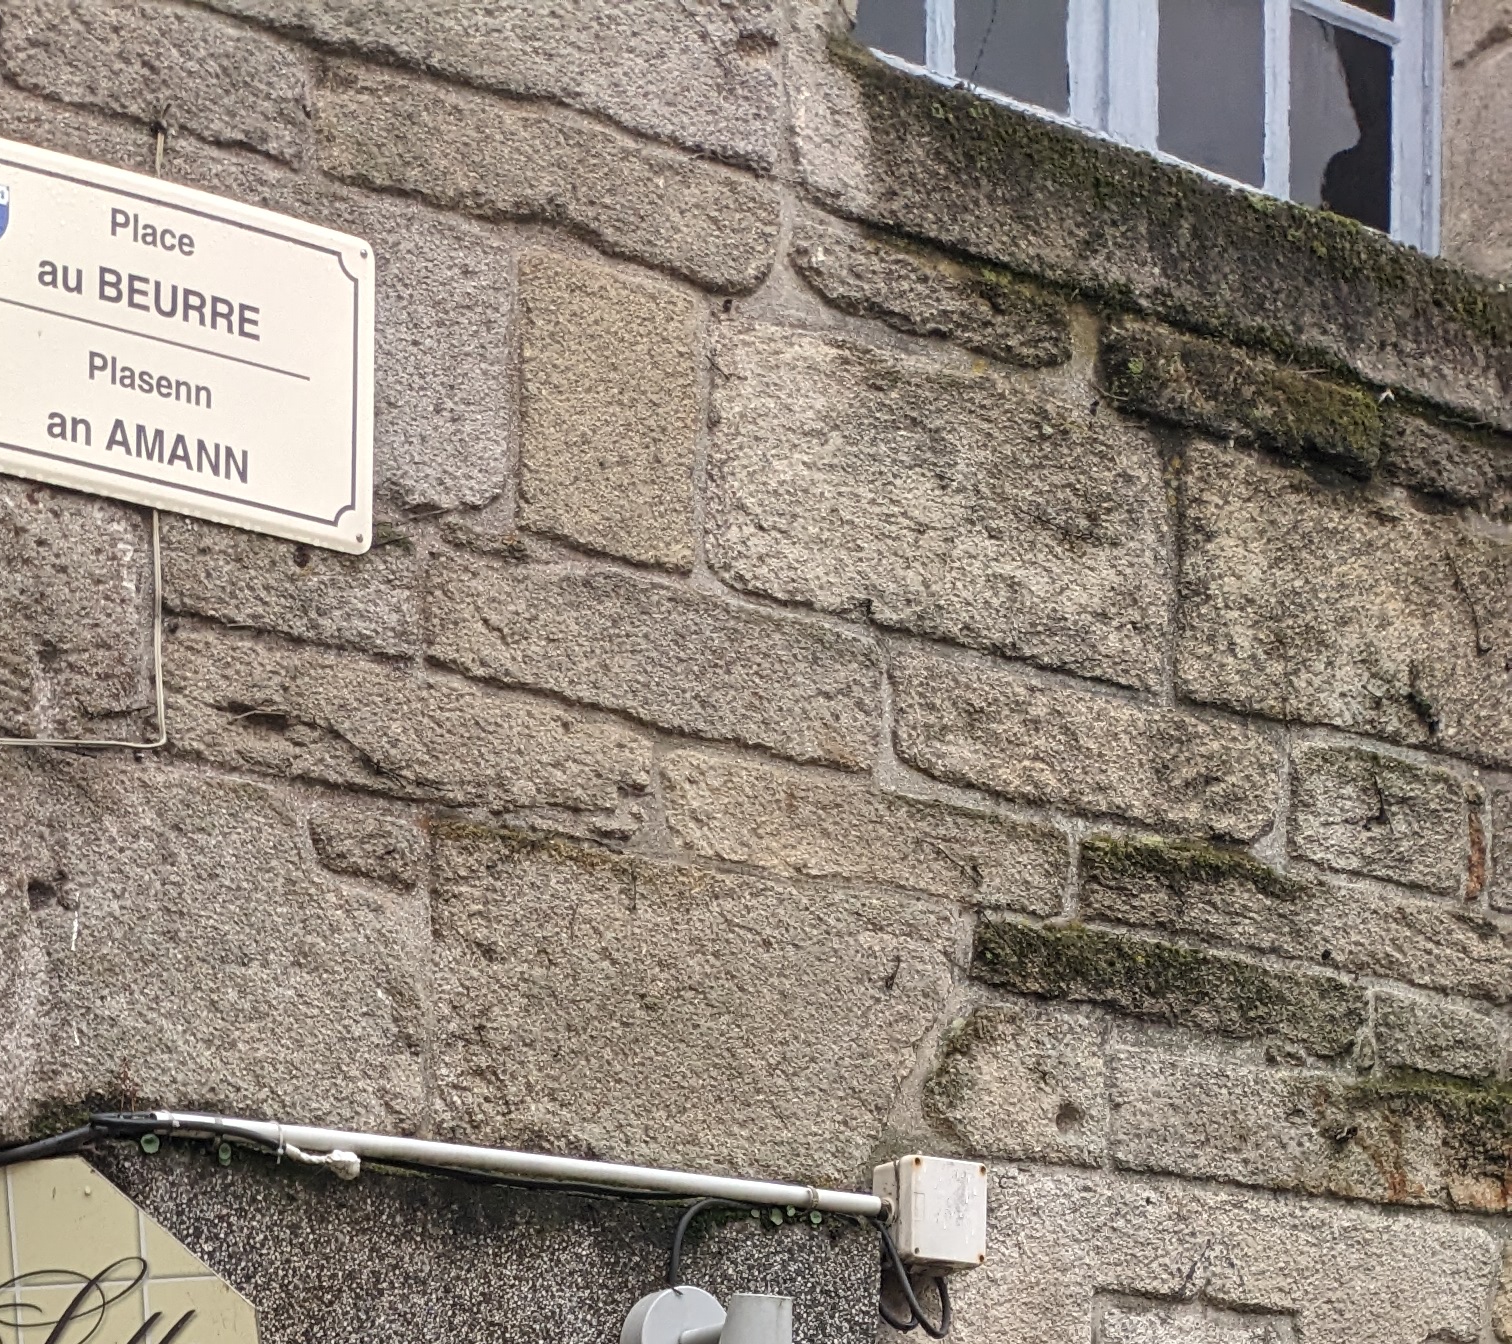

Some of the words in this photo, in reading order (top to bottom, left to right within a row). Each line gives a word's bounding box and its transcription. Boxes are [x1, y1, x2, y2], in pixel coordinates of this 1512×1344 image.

[110, 207, 196, 256] Place
[37, 259, 82, 294] au
[98, 265, 261, 342] BEURRE
[88, 351, 213, 409] Plasenn
[46, 411, 91, 446] an
[105, 419, 249, 484] AMANN
